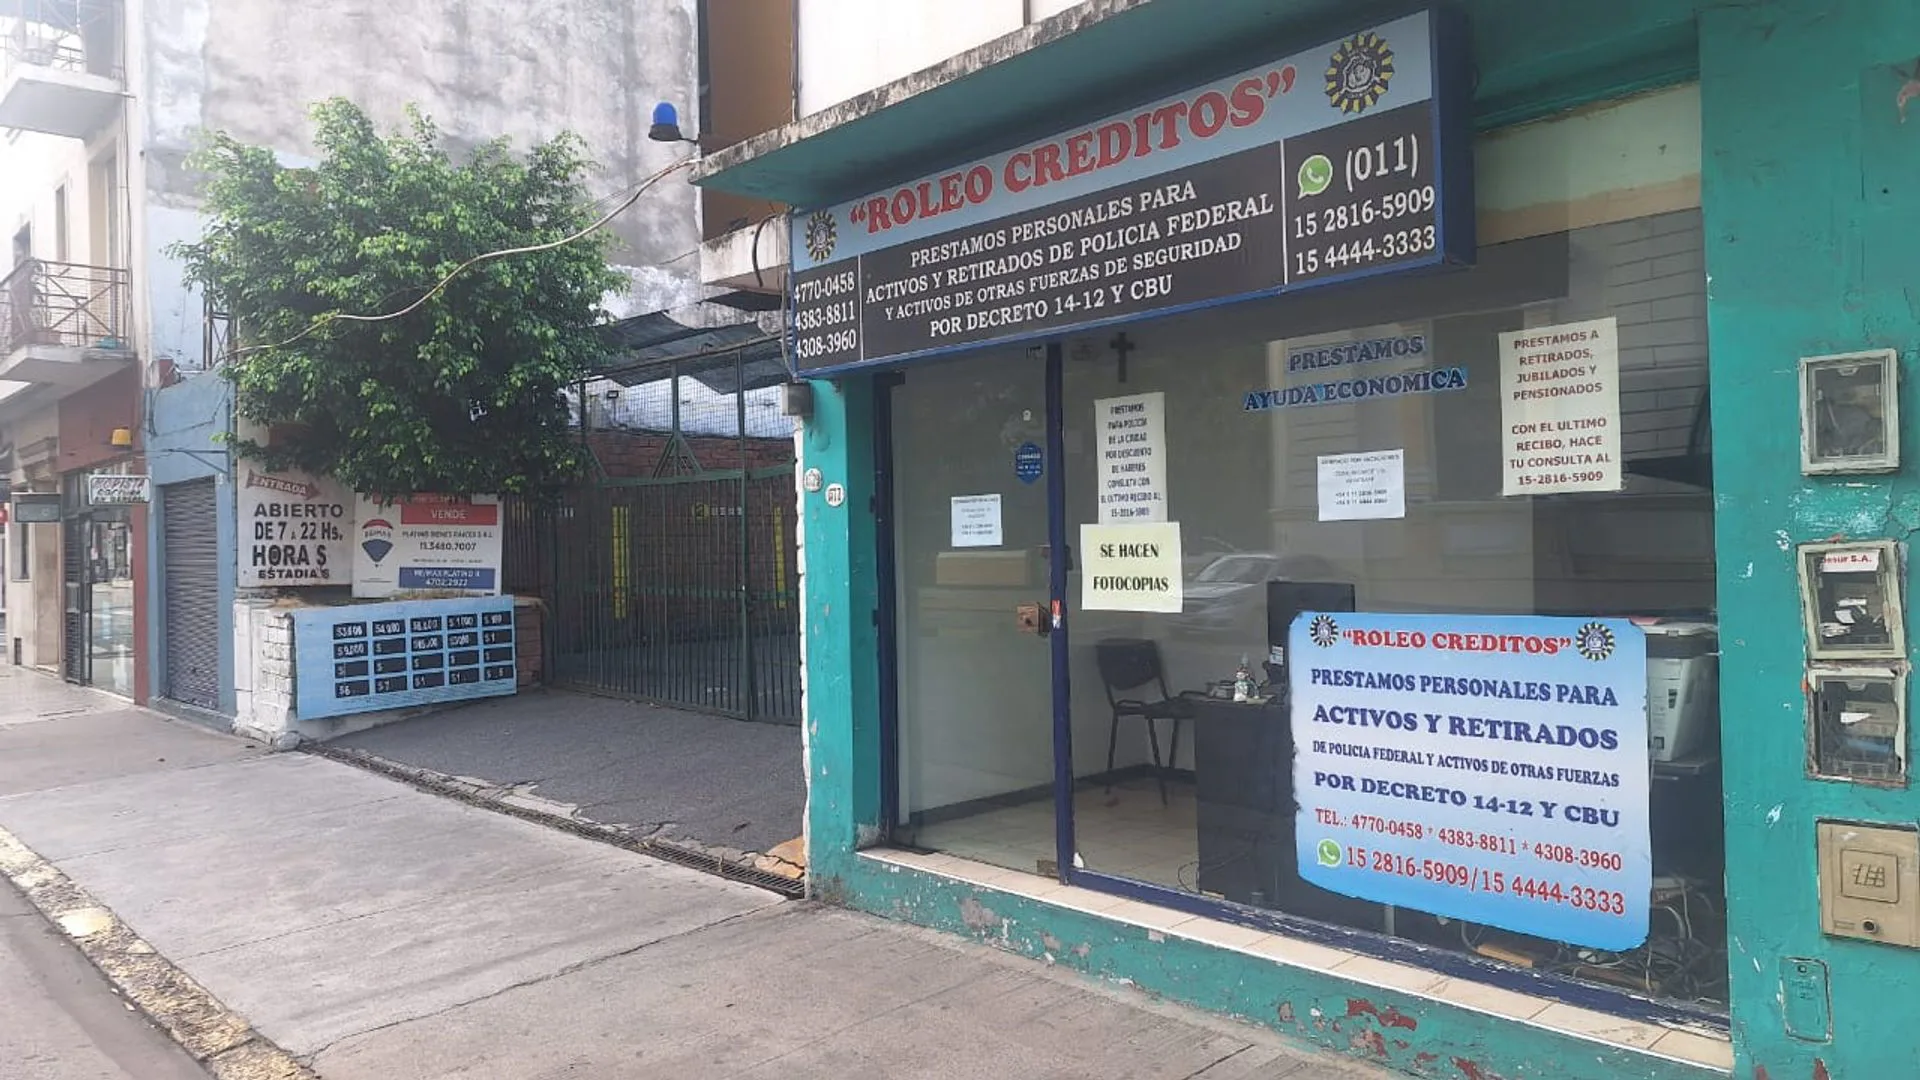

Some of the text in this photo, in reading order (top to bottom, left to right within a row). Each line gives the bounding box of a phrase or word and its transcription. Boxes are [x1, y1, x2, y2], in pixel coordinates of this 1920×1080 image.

[1346, 133, 1418, 193] (011)
[911, 180, 1197, 268] PRESTAMOS PERSONALES PARA
[1295, 185, 1435, 238] 15 2816-5909
[866, 193, 1273, 304] ACTIVOS Y RETIRADOS DE POLICIA FEDERAL
[1296, 225, 1435, 274] 15 4444-3333
[885, 233, 1242, 320] Y ACTIVOS DE OTRAS FUERZAS DE SEGURIDAD
[930, 274, 1173, 338] POR DECRETO 14-12 Y CBU
[1289, 336, 1425, 371] PRESTAMOS
[1514, 330, 1599, 349] PRESTAMOS A
[1519, 348, 1593, 366] RETIRADOS,
[1245, 368, 1465, 411] AYUDA ECONOMICA
[1513, 382, 1603, 401] PENSIONADOS
[1517, 365, 1597, 383] JUBILADOS Y
[1512, 418, 1606, 435] CON EL ULTIMO
[1516, 436, 1603, 451] RECIBO, HACE
[1510, 454, 1611, 469] TU CONSULTA AL
[254, 503, 343, 518] ABIERTO
[431, 509, 467, 519] VENDE
[254, 521, 273, 540] DE
[278, 522, 287, 540] 7
[300, 522, 316, 540] 22
[1100, 543, 1159, 558] SE HACEN
[1093, 576, 1169, 591] FOTOCOPIAS
[1311, 668, 1619, 706] PRESTAMOS PERSONALES PARA
[1313, 704, 1619, 750] ACTIVOS Y RETIRADOS
[1313, 740, 1619, 787] DE POLICIA FEDERAL Y ACTIVOS DE OTRAS FUERZAS
[1314, 771, 1619, 827] POR DECRETO 14-12 Y CBU
[1315, 808, 1622, 871] TEL.: 4770-0458 4383-8811 4308-3960
[1347, 846, 1366, 867] 15
[1512, 876, 1624, 914] 4444-3333
